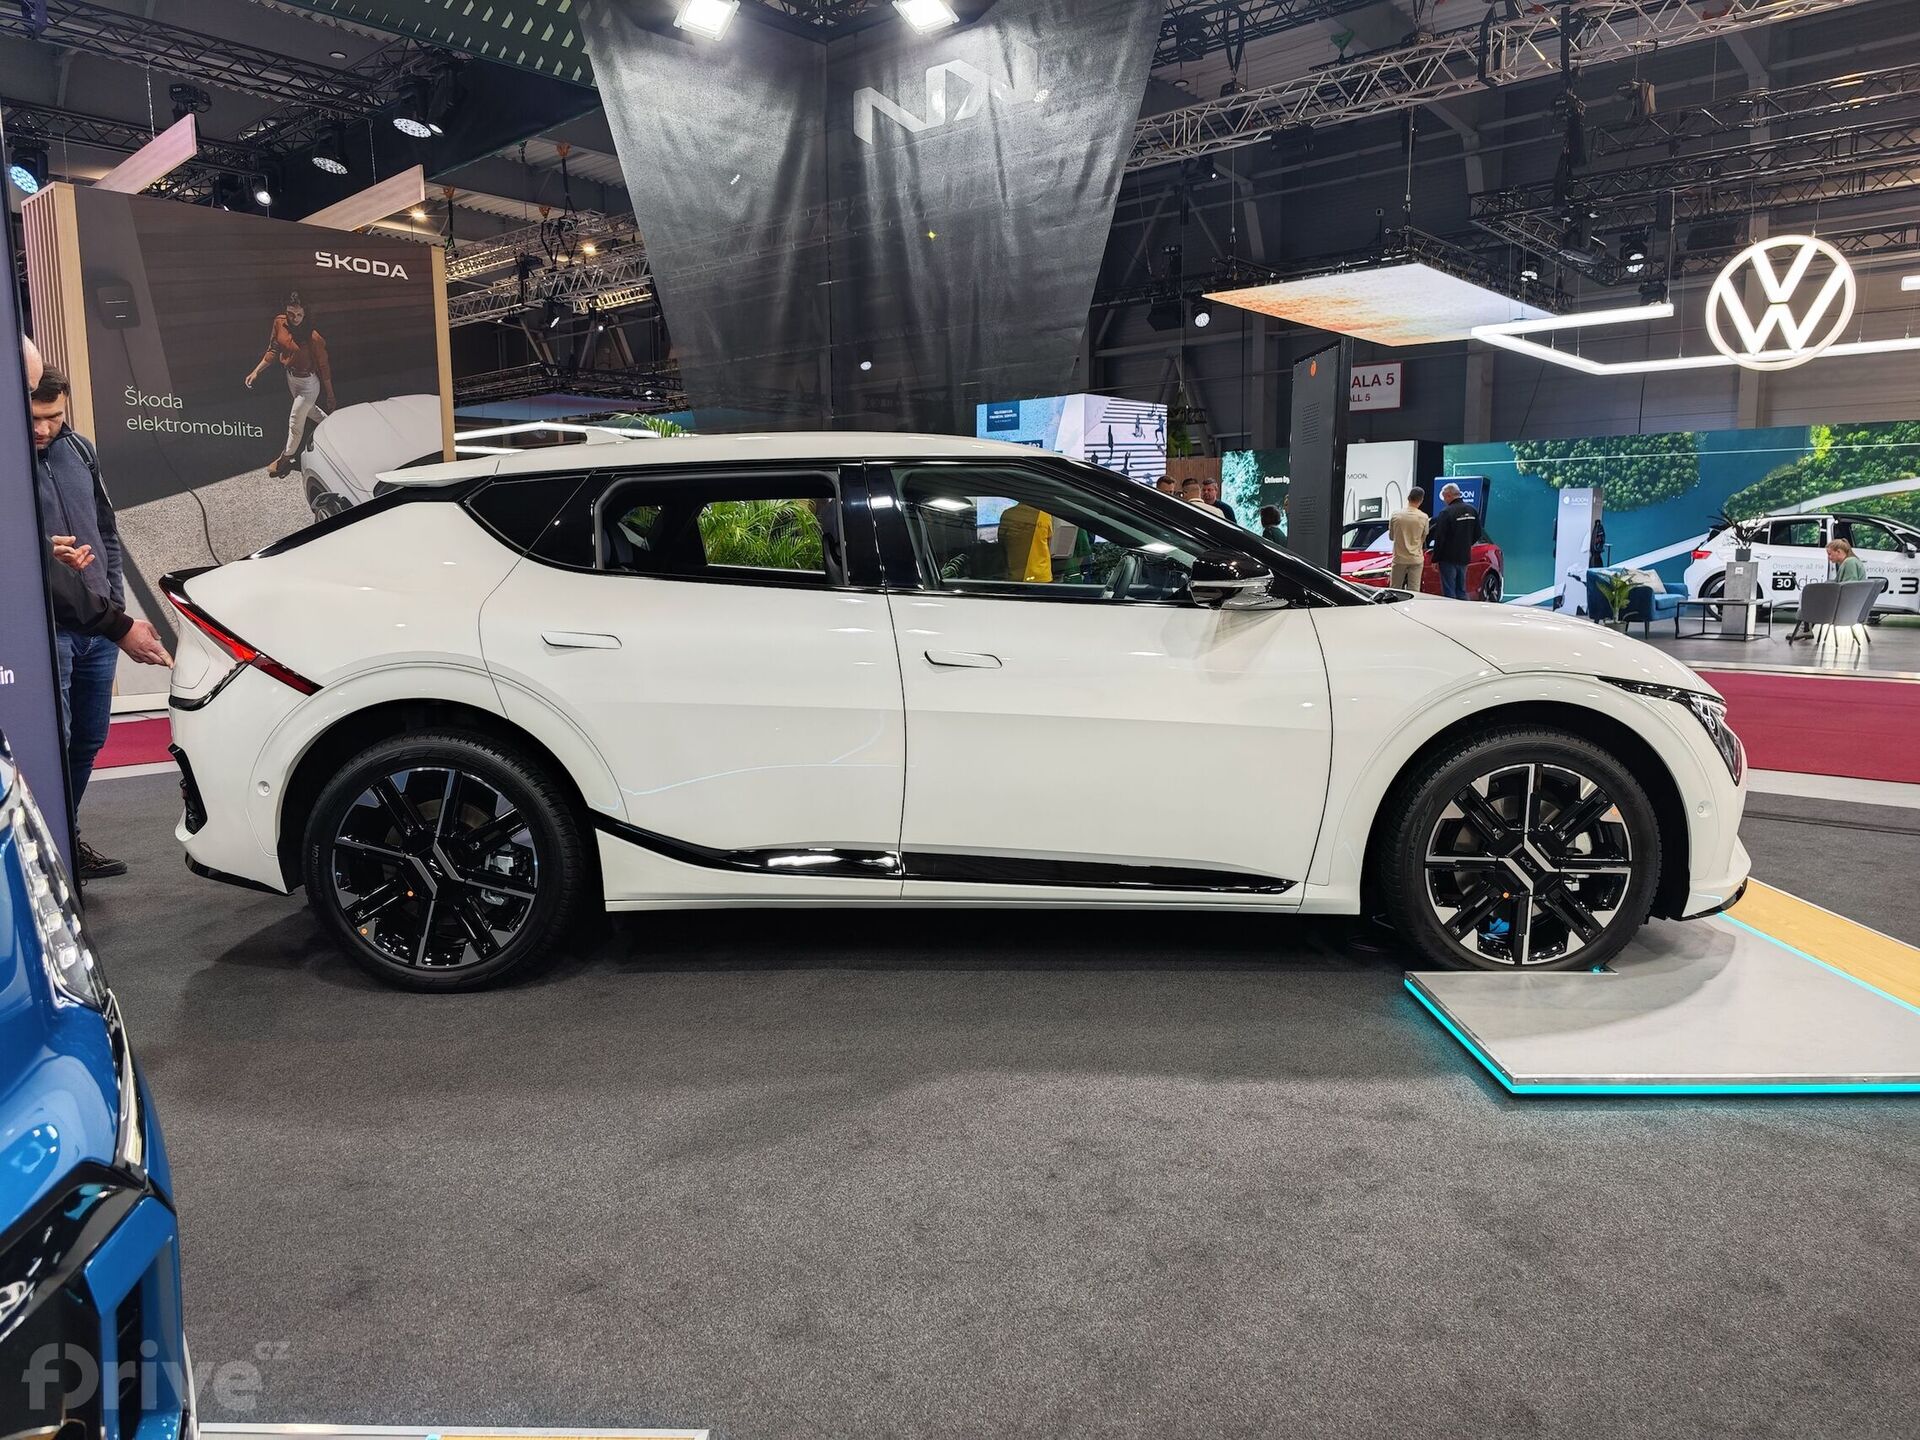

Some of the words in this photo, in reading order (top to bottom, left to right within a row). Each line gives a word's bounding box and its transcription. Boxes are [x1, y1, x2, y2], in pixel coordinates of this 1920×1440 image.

[1352, 373, 1382, 388] ALA
[1385, 372, 1395, 385] 5
[125, 385, 183, 409] Škoda
[127, 415, 263, 438] elektromobilita
[1459, 490, 1475, 498] OON
[1776, 578, 1791, 588] 30
